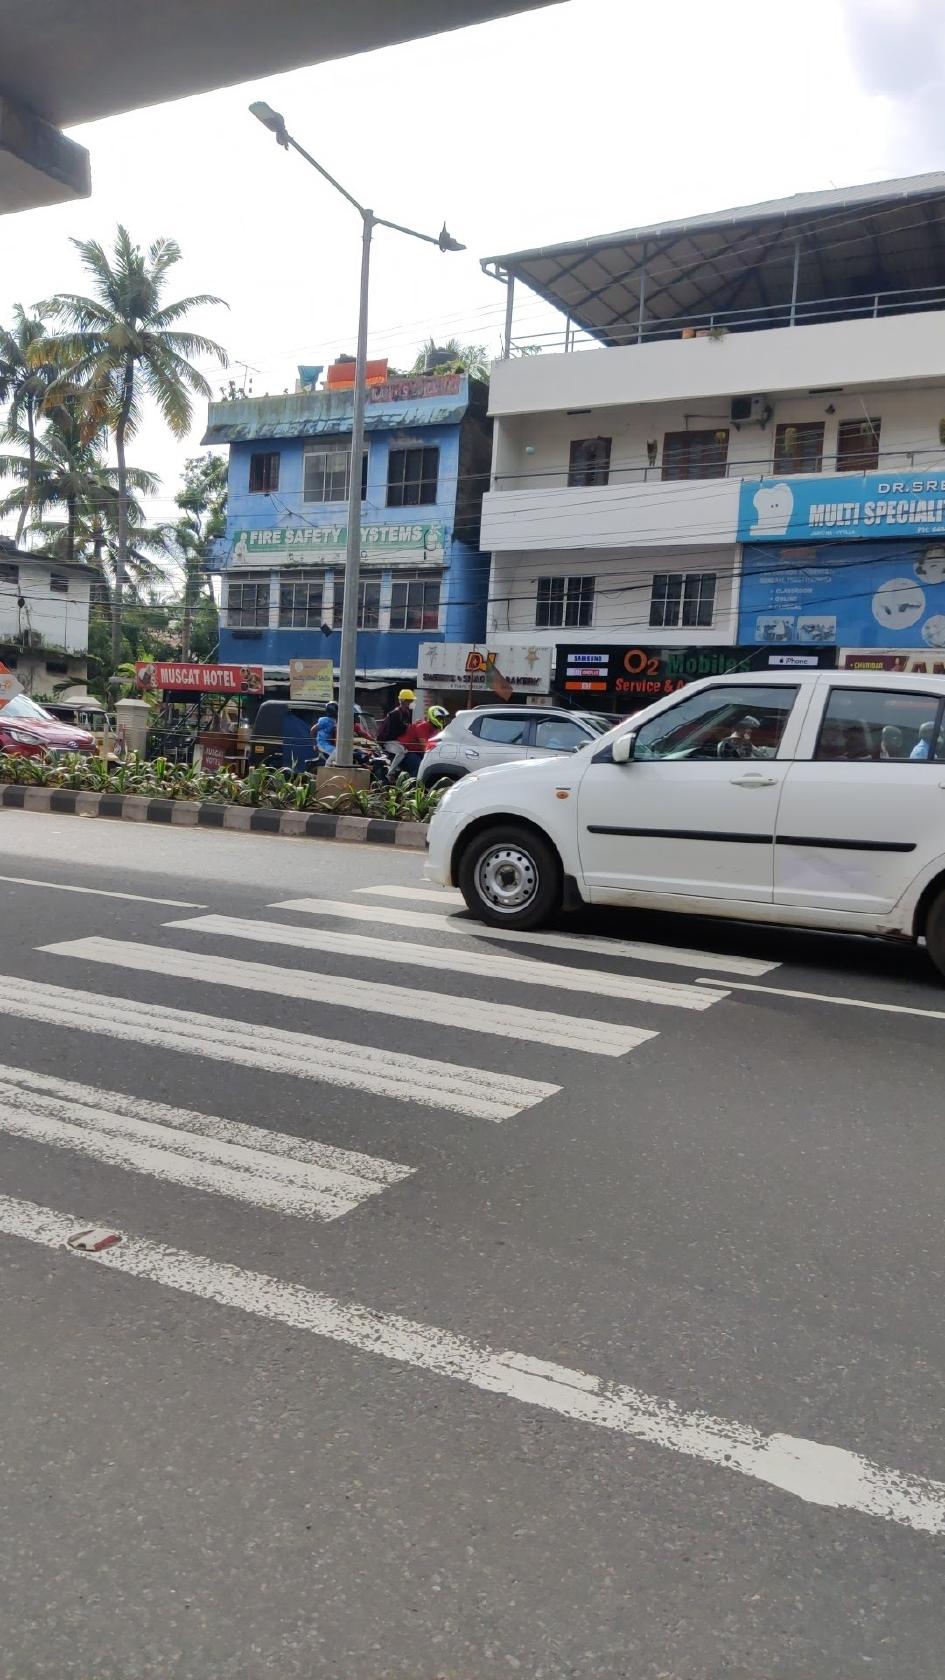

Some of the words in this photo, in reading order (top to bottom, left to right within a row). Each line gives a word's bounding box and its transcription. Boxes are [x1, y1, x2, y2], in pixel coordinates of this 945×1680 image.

[809, 503, 860, 527] MULTI
[863, 499, 945, 525] SPECIALI
[249, 530, 281, 545] FIRE
[284, 527, 342, 545] SAFETY
[359, 525, 424, 543] YSTEMS
[203, 669, 236, 687] HOTEL
[615, 678, 660, 693] Service
[664, 680, 673, 692] &
